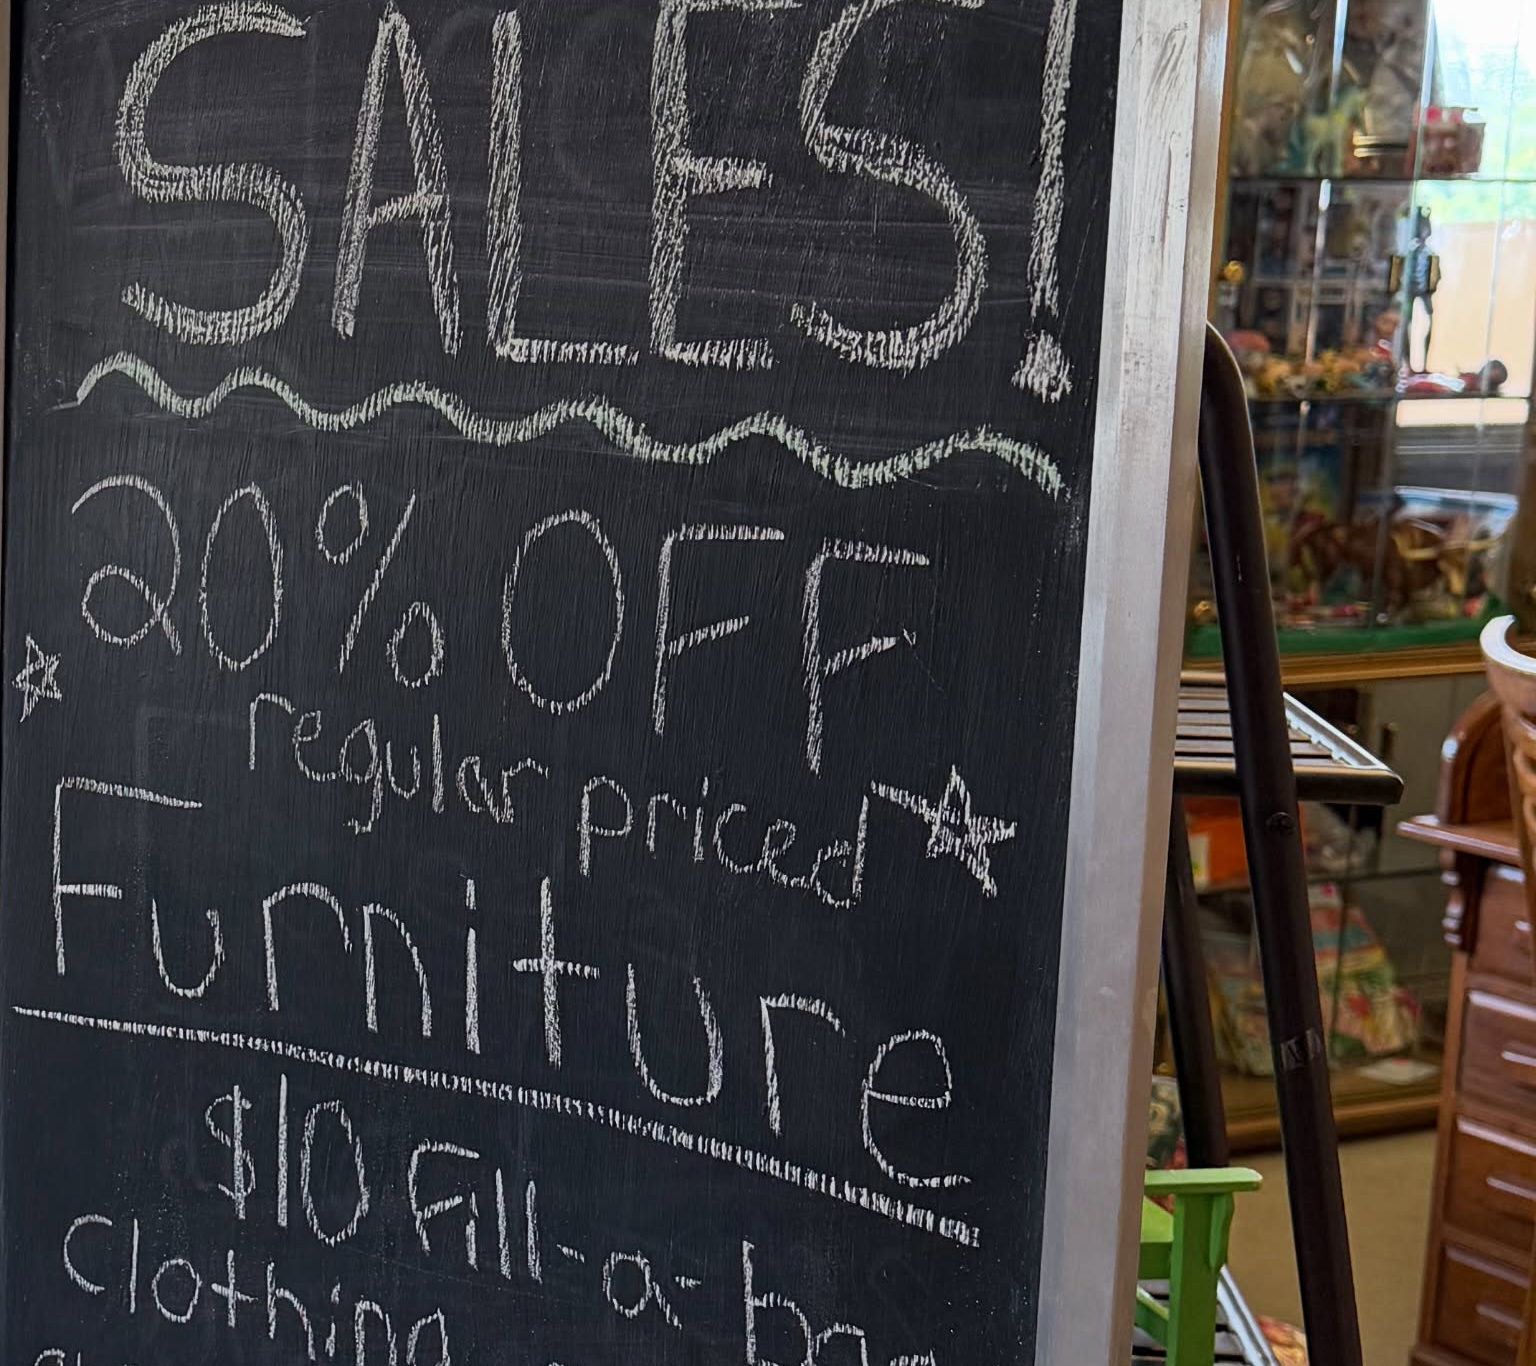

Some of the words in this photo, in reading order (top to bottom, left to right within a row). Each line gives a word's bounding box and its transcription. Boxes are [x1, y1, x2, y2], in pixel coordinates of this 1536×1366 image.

[71, 473, 445, 688] 20%
[501, 507, 932, 775] OFF
[248, 692, 549, 835] regular
[577, 774, 870, 908] priced
[54, 776, 973, 1188] Furniture
[204, 1073, 371, 1246] $10
